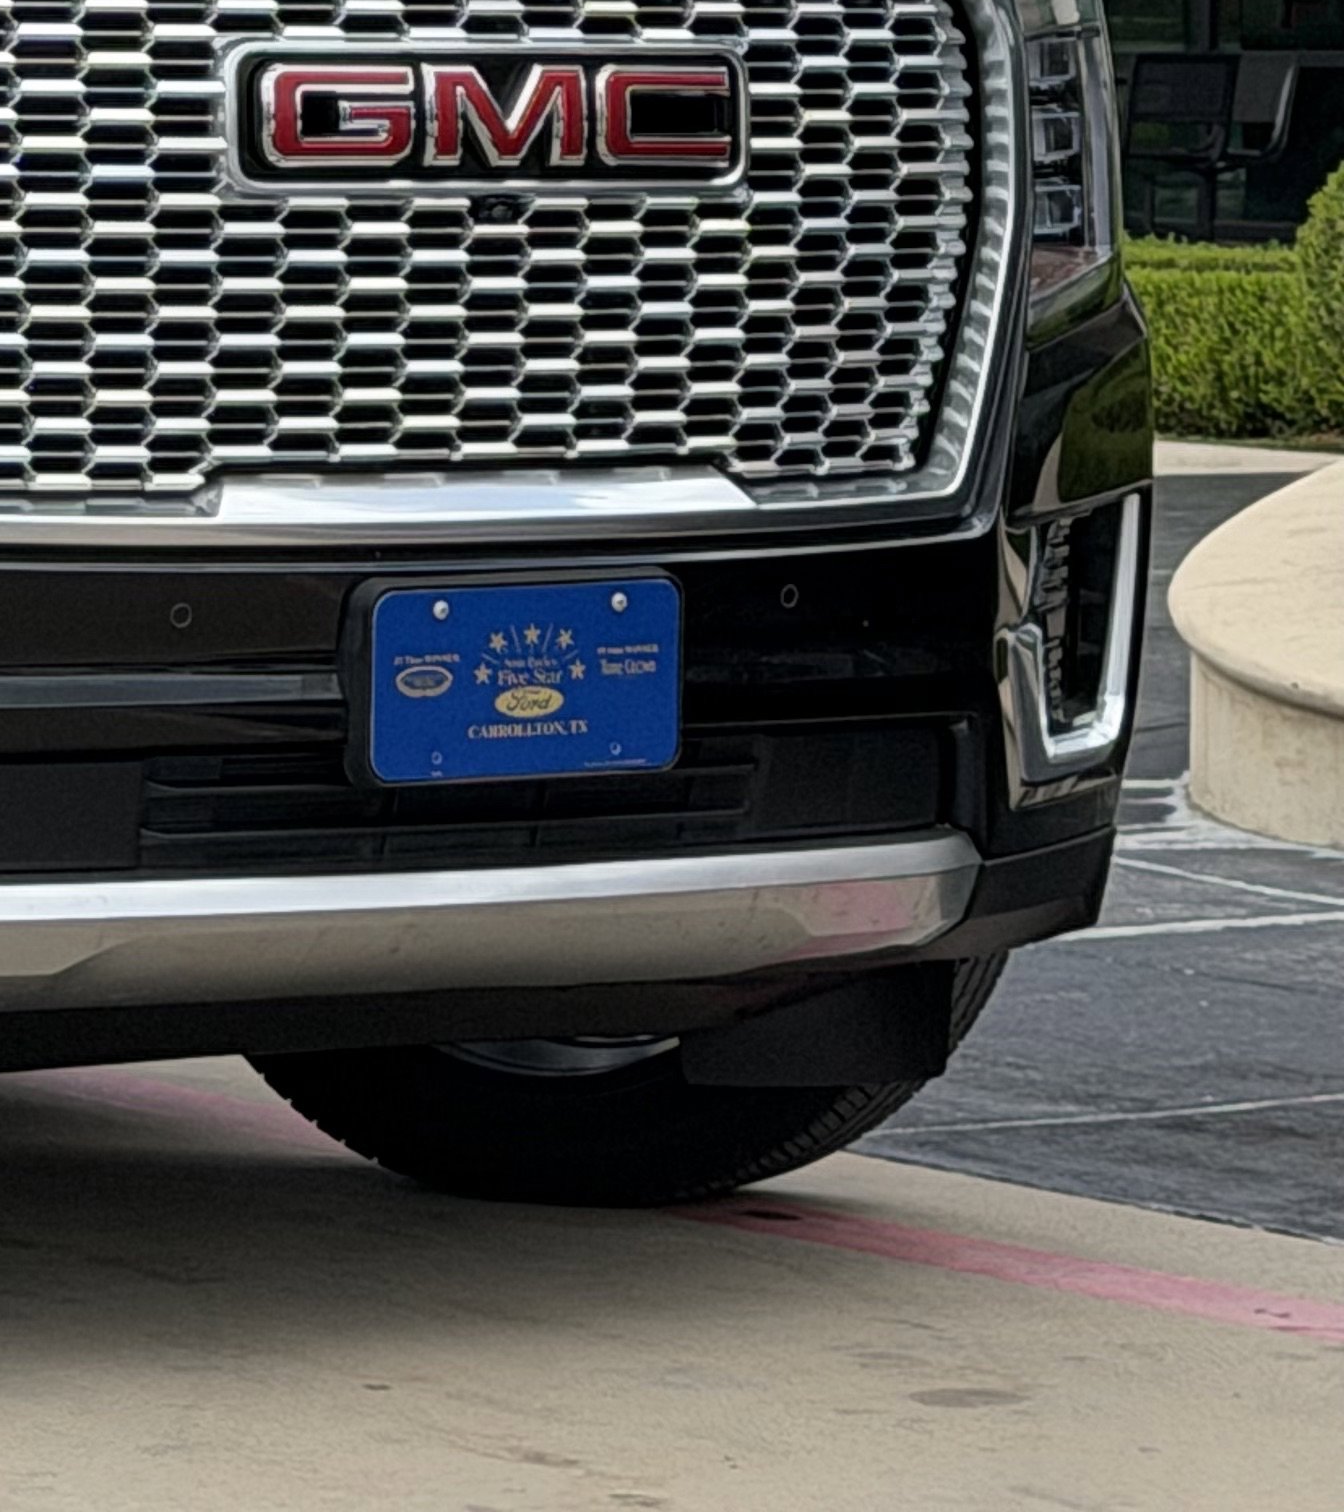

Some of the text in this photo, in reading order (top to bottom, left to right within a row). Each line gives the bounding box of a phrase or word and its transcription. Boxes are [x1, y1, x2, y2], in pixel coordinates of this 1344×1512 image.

[260, 62, 732, 167] GMC
[497, 669, 564, 686] Five Star
[506, 693, 553, 711] Ford
[569, 719, 589, 735] TX
